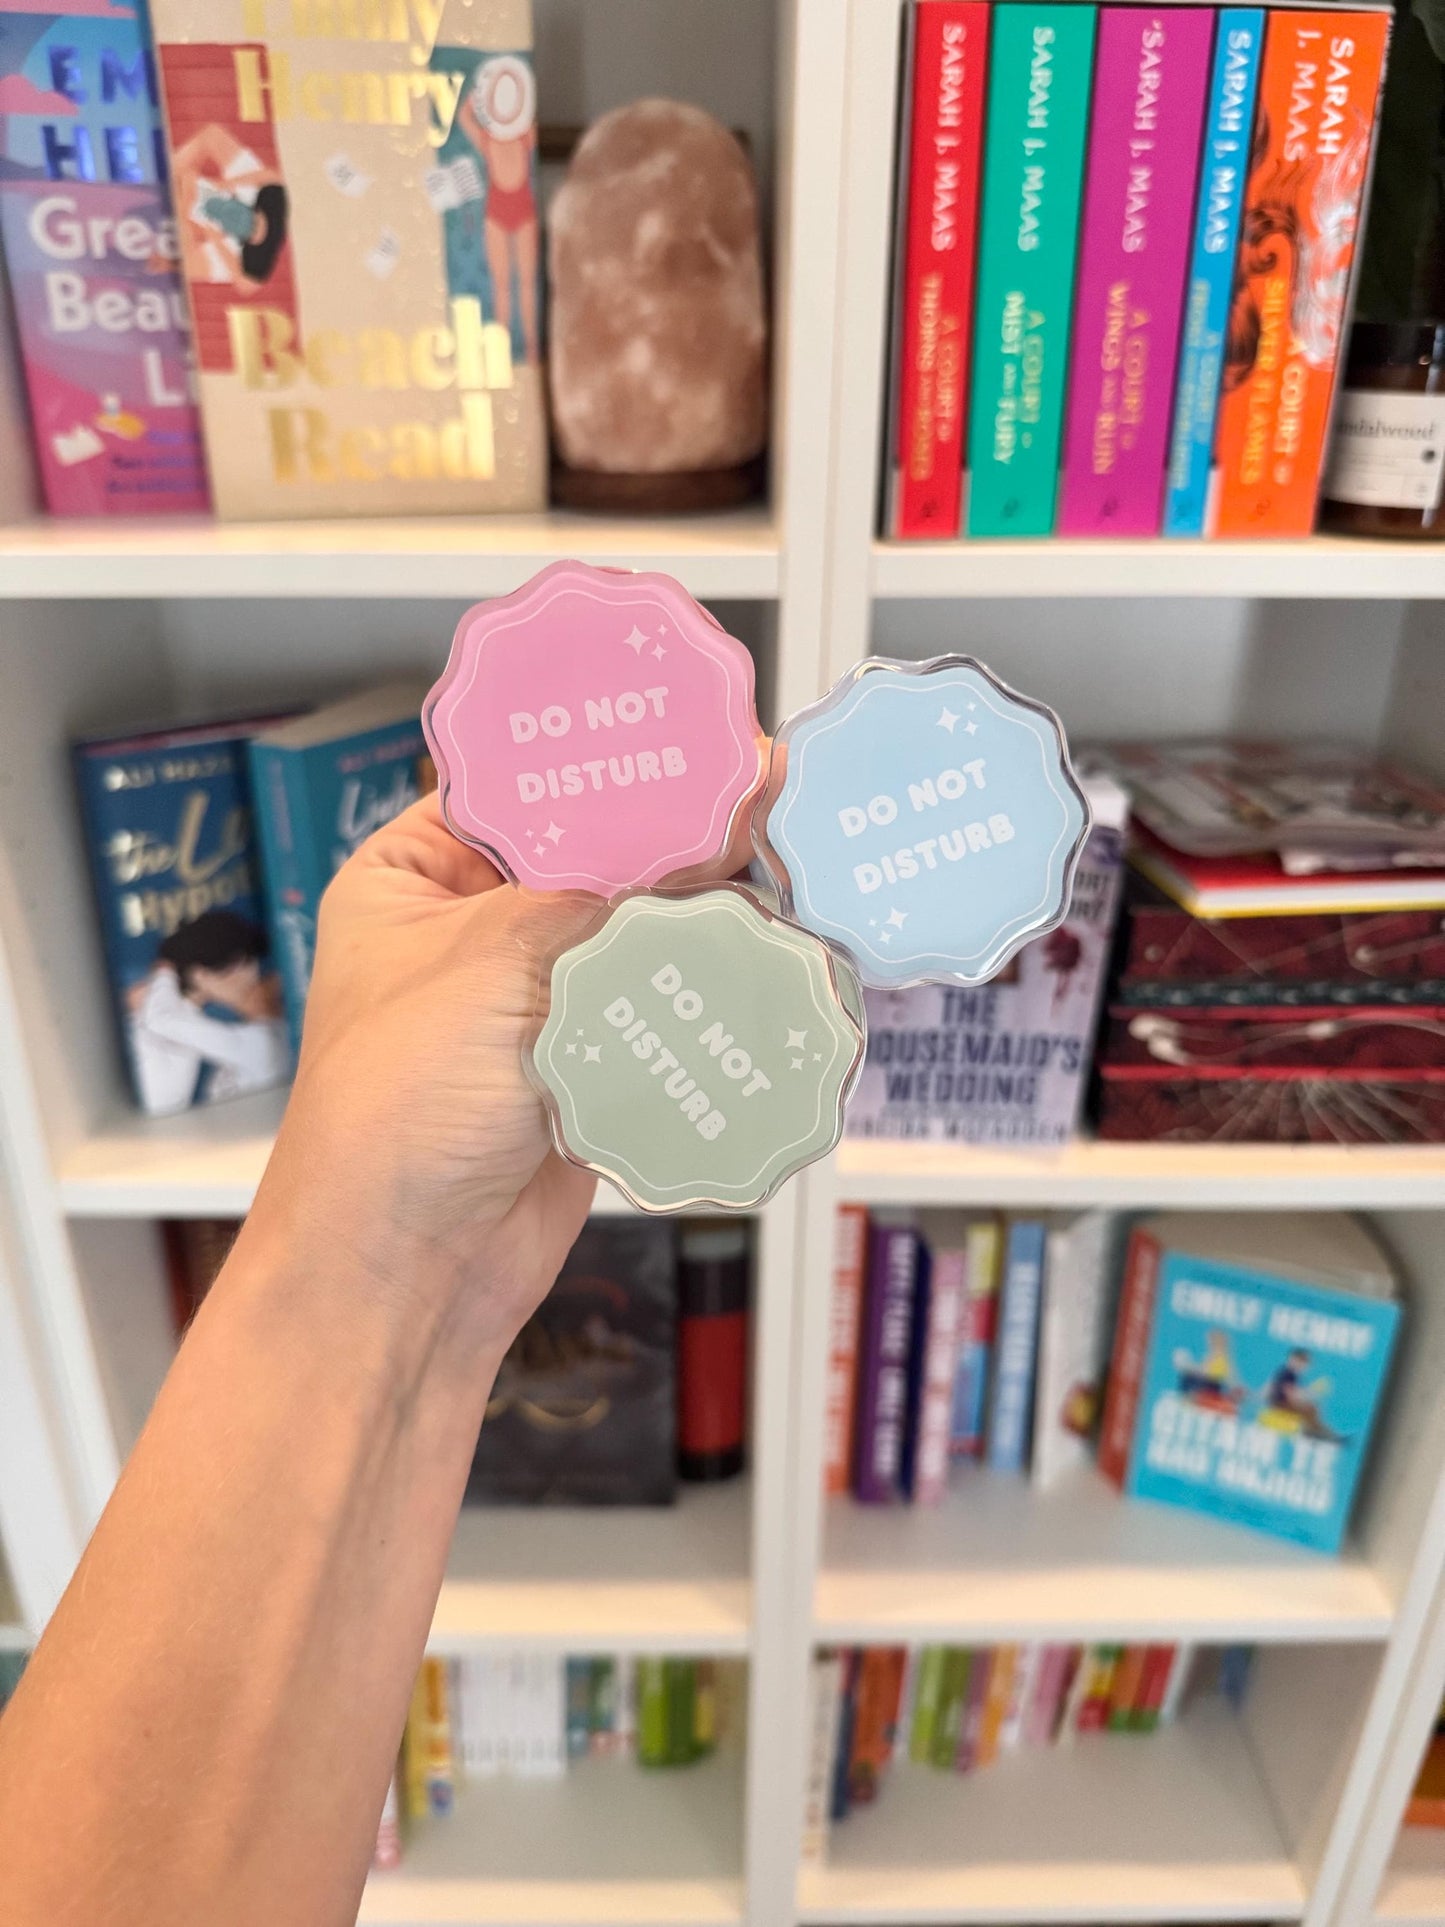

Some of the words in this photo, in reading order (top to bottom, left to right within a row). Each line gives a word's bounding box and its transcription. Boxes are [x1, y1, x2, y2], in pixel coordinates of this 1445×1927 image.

[938, 21, 966, 127] SARAH
[1027, 26, 1055, 128] SARAH
[1134, 28, 1165, 131] SARAH
[1219, 29, 1253, 132] SARAH
[1297, 30, 1322, 48] J.
[234, 50, 465, 148] Henry
[1283, 62, 1317, 162] MAAS
[1316, 37, 1355, 155] SARAH
[931, 161, 960, 252] MAAS
[1018, 165, 1045, 252] MAAS
[1122, 167, 1152, 253] MAAS
[1204, 166, 1236, 254] MAAS
[226, 295, 513, 391] Beach
[266, 391, 496, 485] Read
[1274, 361, 1307, 457] COURT
[509, 705, 571, 743] DO
[584, 686, 669, 730] NOT
[517, 746, 688, 804] DISTURB
[838, 795, 898, 837] DO
[908, 758, 986, 812] NOT
[853, 813, 1015, 894] DISTURB
[650, 963, 704, 1021] DO
[698, 1021, 772, 1097] NOT
[942, 987, 997, 1026] THE
[603, 996, 727, 1141] DISTURB
[885, 1071, 1038, 1105] WEDDING
